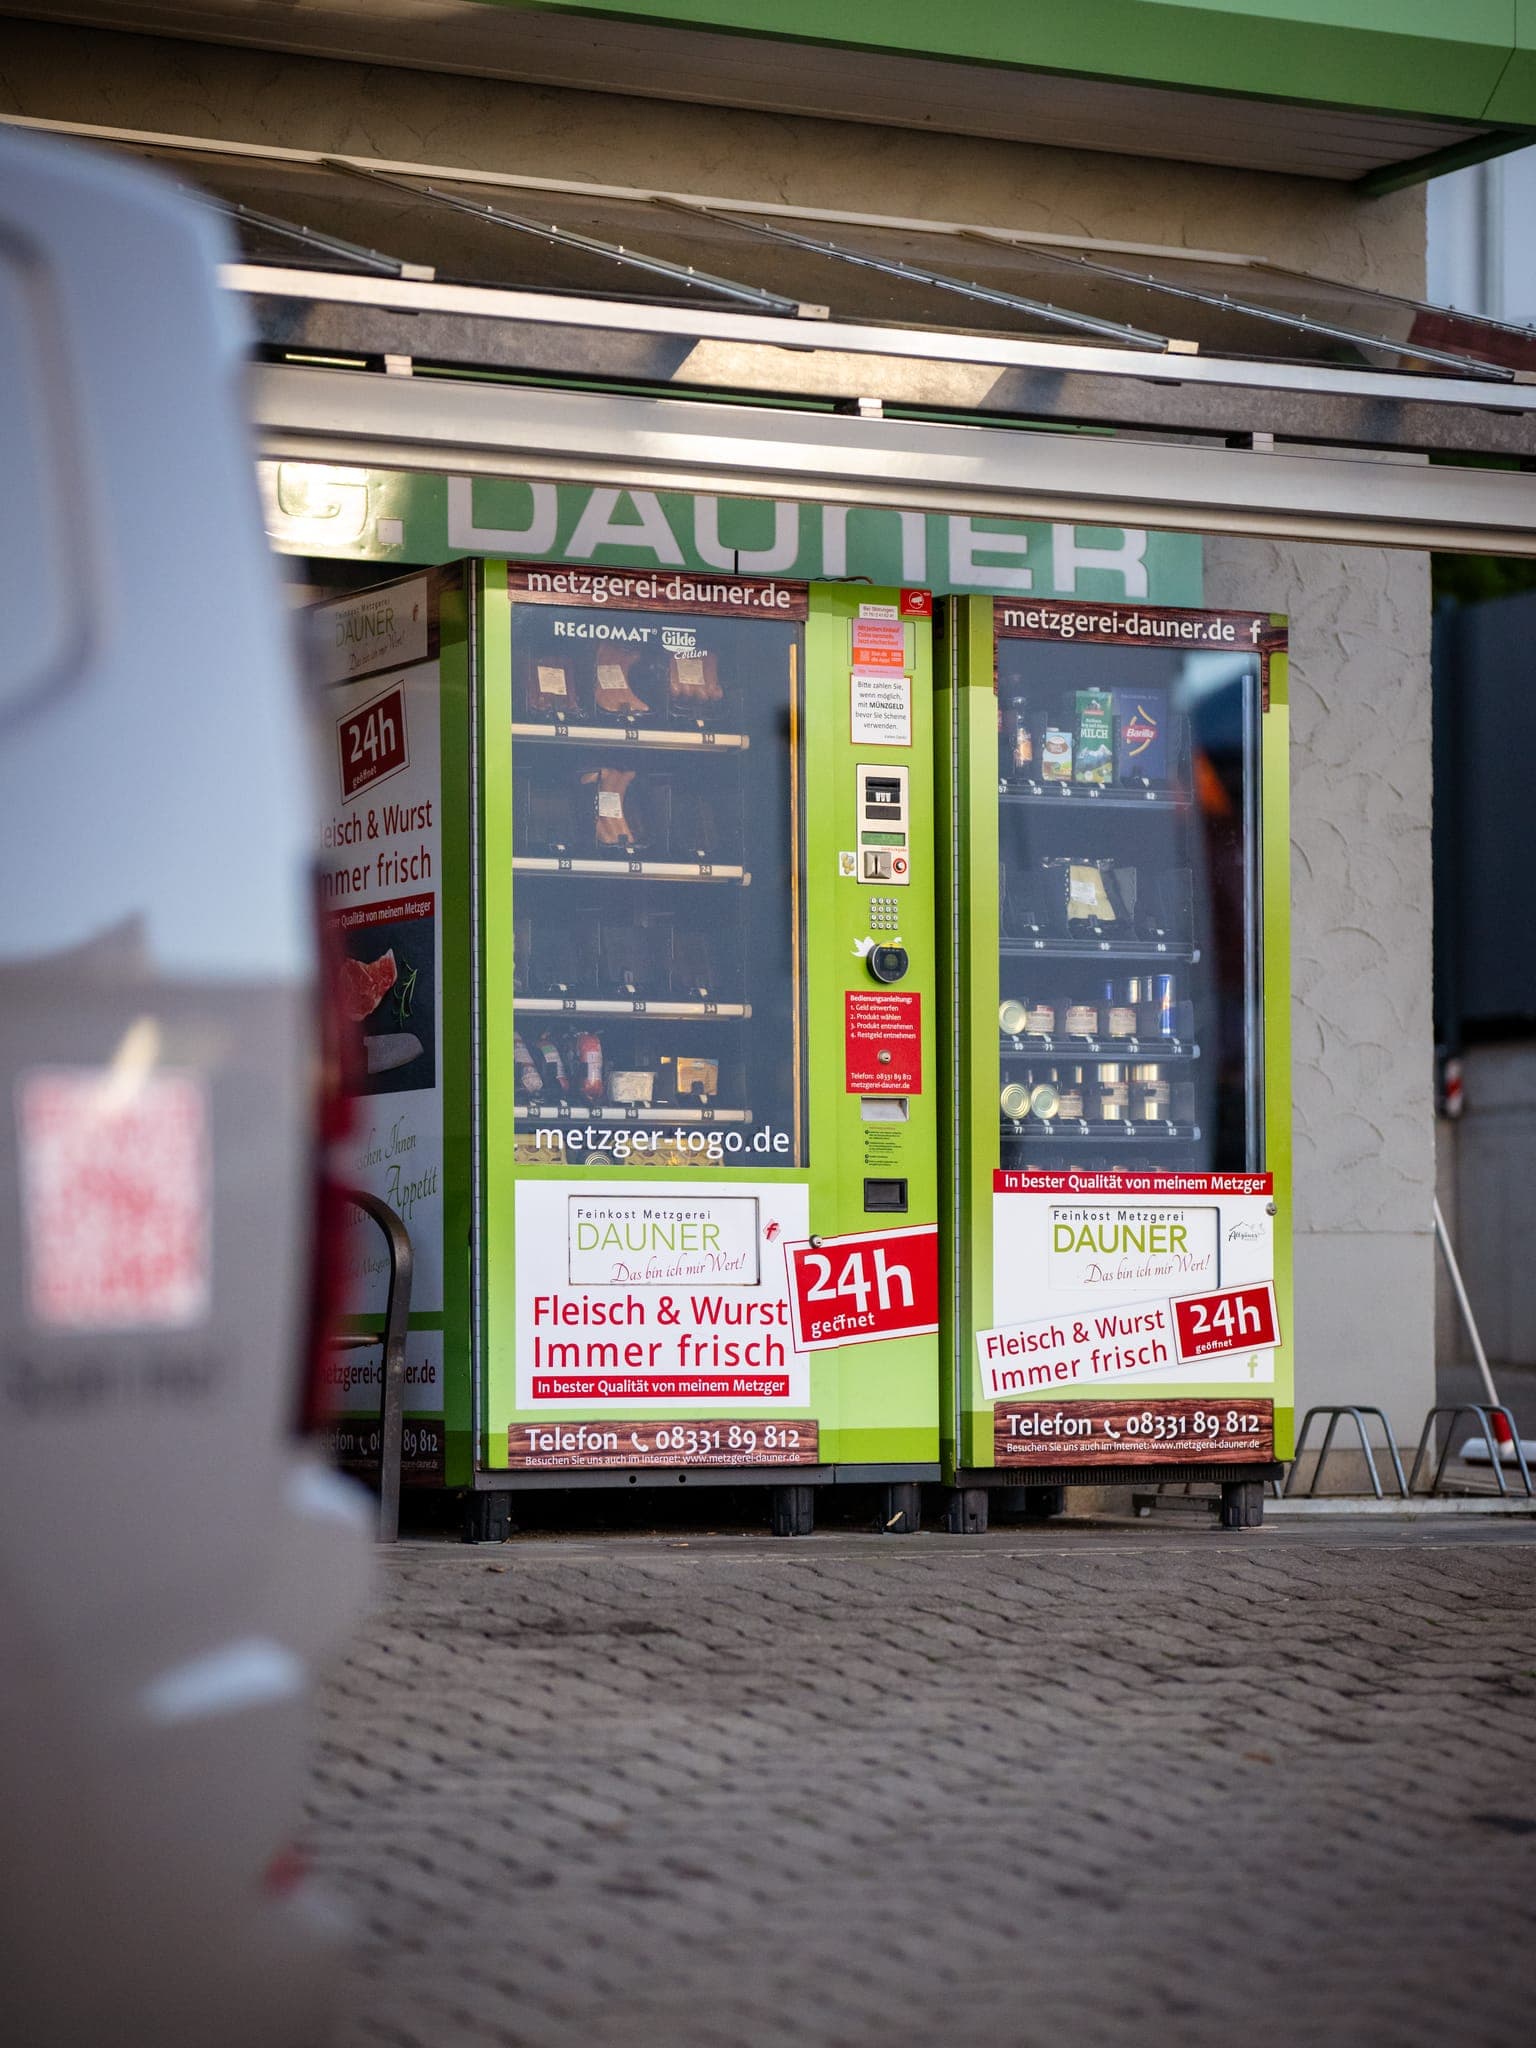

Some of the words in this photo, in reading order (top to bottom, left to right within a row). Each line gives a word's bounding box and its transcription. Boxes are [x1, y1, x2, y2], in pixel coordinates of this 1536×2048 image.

[447, 475, 1149, 598] DAUNER
[527, 571, 790, 608] metzgerei-dauner.de
[336, 608, 394, 648] DAUNER
[1004, 609, 1235, 641] metzgerei-dauner.de
[662, 630, 696, 646] Gilde
[674, 649, 708, 660] Edition
[869, 701, 904, 710] MÜNZGELD
[349, 707, 396, 764] 24h
[558, 727, 568, 736] 12
[627, 730, 637, 739] 13
[1081, 728, 1108, 739] MILCH
[1127, 728, 1154, 739] Barilla
[320, 812, 362, 848] leisch
[367, 810, 379, 839] &
[383, 800, 432, 836] Wurst
[320, 864, 371, 897] mmer
[377, 845, 431, 887] frisch
[560, 860, 570, 868] 22
[631, 862, 641, 871] 23
[701, 865, 711, 874] 24
[341, 911, 365, 928] Qualität
[366, 911, 378, 922] von
[378, 905, 404, 919] meinem
[405, 901, 432, 917] Metzger
[565, 1001, 575, 1009] 32
[635, 1002, 645, 1011] 33
[857, 1031, 882, 1040] Restgeld
[851, 1082, 910, 1090] metzgerei-dauner.de
[876, 1073, 892, 1081] 08331
[894, 1073, 901, 1081] 89
[559, 1108, 569, 1116] 44
[591, 1109, 601, 1117] 45
[703, 1110, 713, 1118] 47
[385, 1115, 417, 1159] Ihnen
[536, 1125, 790, 1160] metzger-togo.de
[386, 1165, 438, 1221] Appetit
[1005, 1175, 1018, 1188] In
[1021, 1175, 1065, 1190] bester
[1068, 1174, 1122, 1193] Qualität
[1125, 1179, 1151, 1189] von
[1153, 1176, 1207, 1190] meinem
[1210, 1177, 1266, 1194] Metzger
[578, 1209, 636, 1219] Feinkost
[643, 1210, 711, 1221] Metzgerei
[1053, 1210, 1111, 1221] Feinkost
[1117, 1211, 1184, 1224] Metzgerei
[577, 1223, 720, 1251] DAUNER
[1053, 1224, 1188, 1253] DAUNER
[611, 1262, 641, 1282] Das
[646, 1256, 662, 1280] bin
[666, 1253, 687, 1277] ich
[686, 1262, 706, 1276] mir
[700, 1253, 746, 1274] Wert!
[1083, 1264, 1114, 1284] Das
[1117, 1257, 1133, 1280] bin
[1136, 1254, 1158, 1277] ich
[1154, 1264, 1174, 1276] mir
[1172, 1253, 1211, 1272] Wert!
[803, 1248, 915, 1313] 24h
[534, 1296, 645, 1325] Fleisch
[657, 1297, 681, 1325] &
[692, 1296, 788, 1325] Wurst
[1189, 1296, 1262, 1337] 24h
[986, 1326, 1065, 1359] Fleisch
[1072, 1322, 1089, 1343] &
[1094, 1309, 1165, 1340] Wurst
[534, 1337, 662, 1367] Immer
[677, 1334, 785, 1367] frisch
[1195, 1339, 1232, 1355] geöffnet
[321, 1359, 436, 1392] etzgerei-er.de
[991, 1359, 1080, 1392] Immer
[1090, 1339, 1167, 1374] frisch
[538, 1381, 551, 1393] In
[553, 1380, 595, 1394] bester
[597, 1379, 649, 1396] Qualität
[651, 1382, 677, 1393] von
[680, 1380, 729, 1393] meinem
[733, 1379, 785, 1397] Metzger
[1007, 1411, 1092, 1436] Telefon
[1126, 1411, 1186, 1440] 08331
[1193, 1412, 1220, 1438] 89
[1226, 1411, 1260, 1433] 812
[320, 1427, 354, 1452] elefon
[403, 1429, 417, 1457] 89
[420, 1429, 438, 1452] 812
[525, 1427, 617, 1451] Telefon
[656, 1426, 720, 1454] 08331
[728, 1426, 757, 1454] 89
[764, 1425, 801, 1449] 812
[1006, 1442, 1047, 1453] Besuchen
[1049, 1442, 1062, 1452] Sie
[1063, 1443, 1078, 1452] uns
[1079, 1441, 1100, 1452] auch
[1101, 1441, 1113, 1451] im
[1113, 1441, 1149, 1451] Internet:
[1150, 1439, 1259, 1452] www.metzgerei-dauner.de
[525, 1455, 569, 1466] Besuchen
[571, 1455, 585, 1465] Sie
[587, 1456, 602, 1465] uns
[603, 1454, 626, 1464] auch
[628, 1454, 640, 1463] im
[641, 1454, 681, 1464] Internet:
[682, 1453, 801, 1466] www.metzgerei-dauner.de
